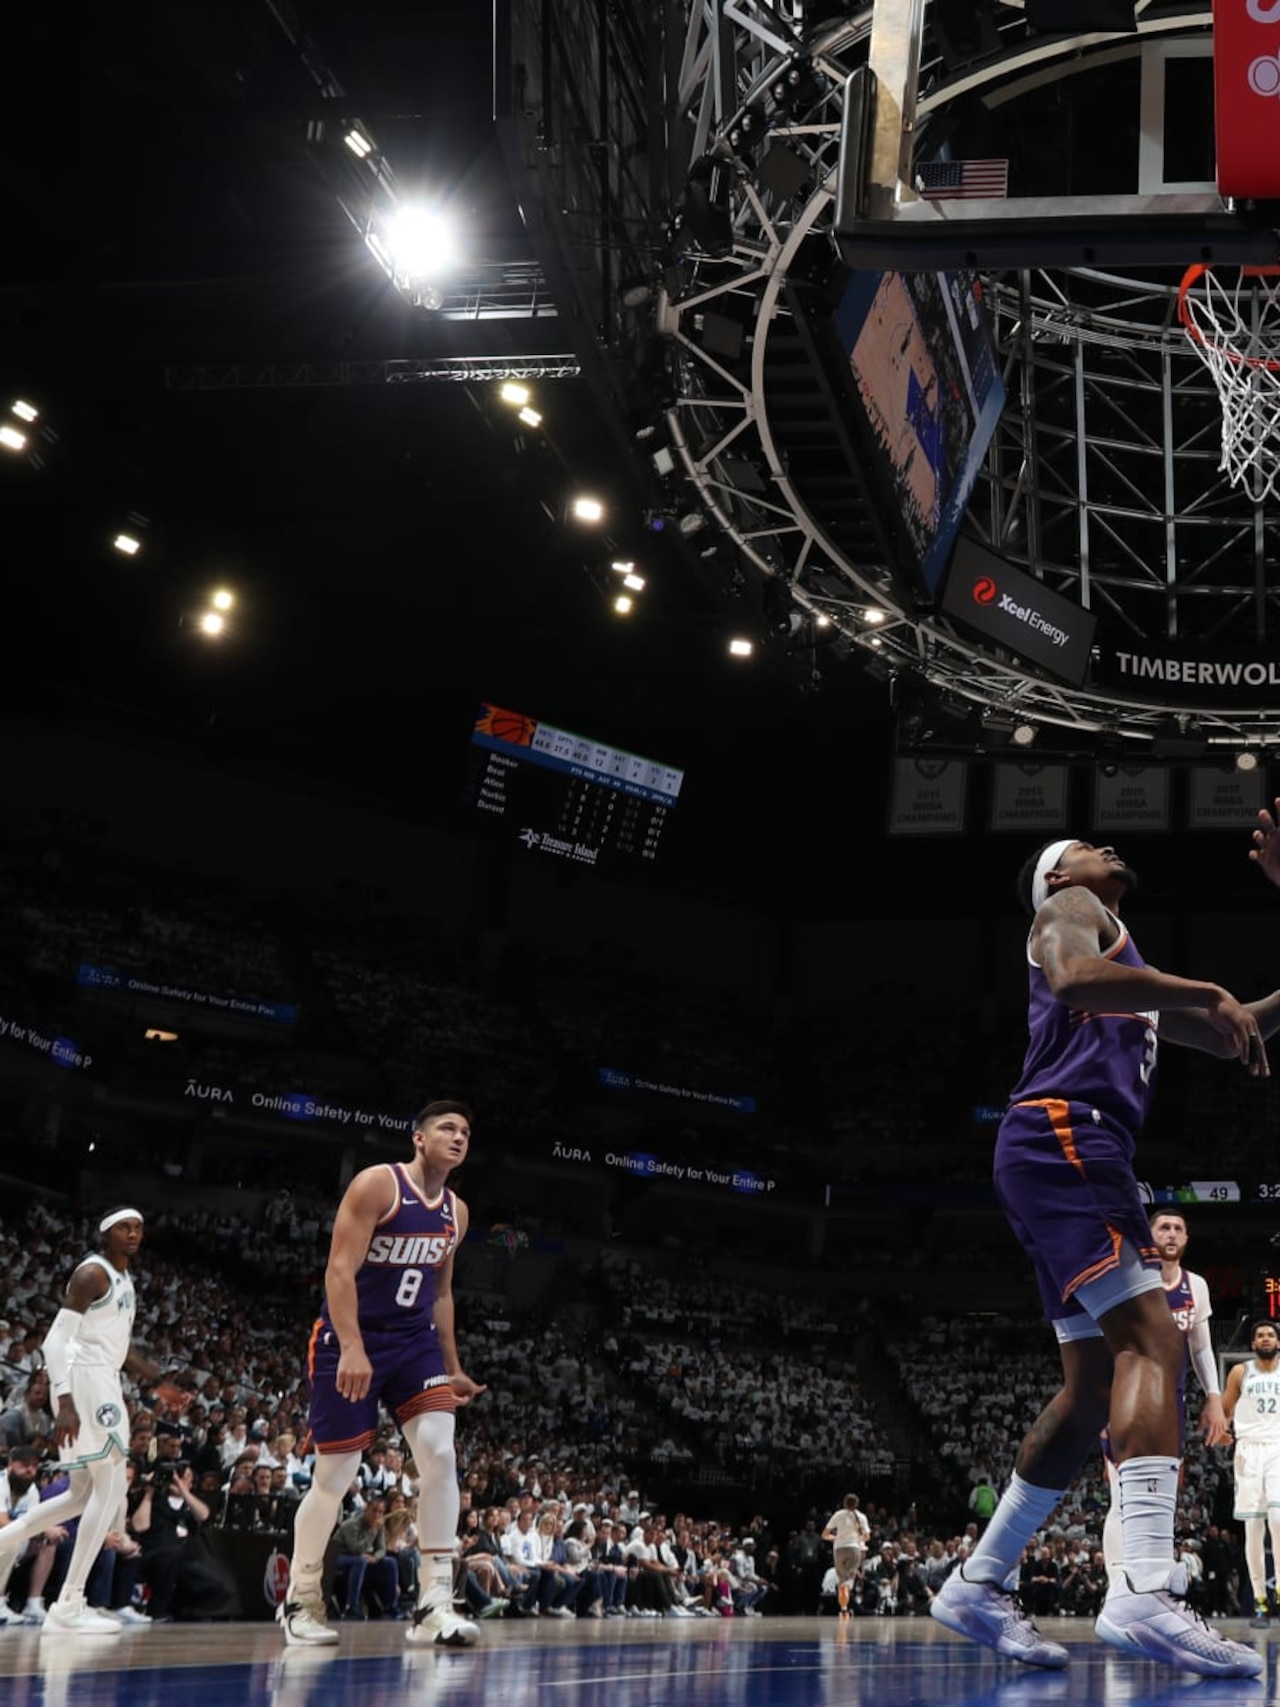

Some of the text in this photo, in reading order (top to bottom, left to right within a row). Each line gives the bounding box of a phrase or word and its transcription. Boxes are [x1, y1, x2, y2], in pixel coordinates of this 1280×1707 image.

[897, 811, 958, 822] CHAMPIONS
[999, 809, 1060, 820] CHAMPIONS
[1100, 810, 1162, 820] CHAMPIONS
[127, 977, 161, 995] Online
[161, 984, 192, 1002] Safety
[190, 990, 206, 1003] for
[208, 994, 229, 1008] Your
[27, 1027, 52, 1052] Your
[251, 1092, 300, 1112] Online
[304, 1101, 351, 1124] Safety
[354, 1109, 375, 1126] for
[377, 1114, 409, 1131] Your
[604, 1152, 645, 1171] Online
[646, 1159, 685, 1180] Safety
[687, 1166, 704, 1181] for
[704, 1170, 731, 1186] Your
[731, 1174, 766, 1192] Entire
[766, 1179, 777, 1192] P
[1210, 1186, 1228, 1201] 49
[367, 1235, 446, 1265] SUNS
[395, 1267, 424, 1308] 8
[1256, 1398, 1277, 1414] 32
